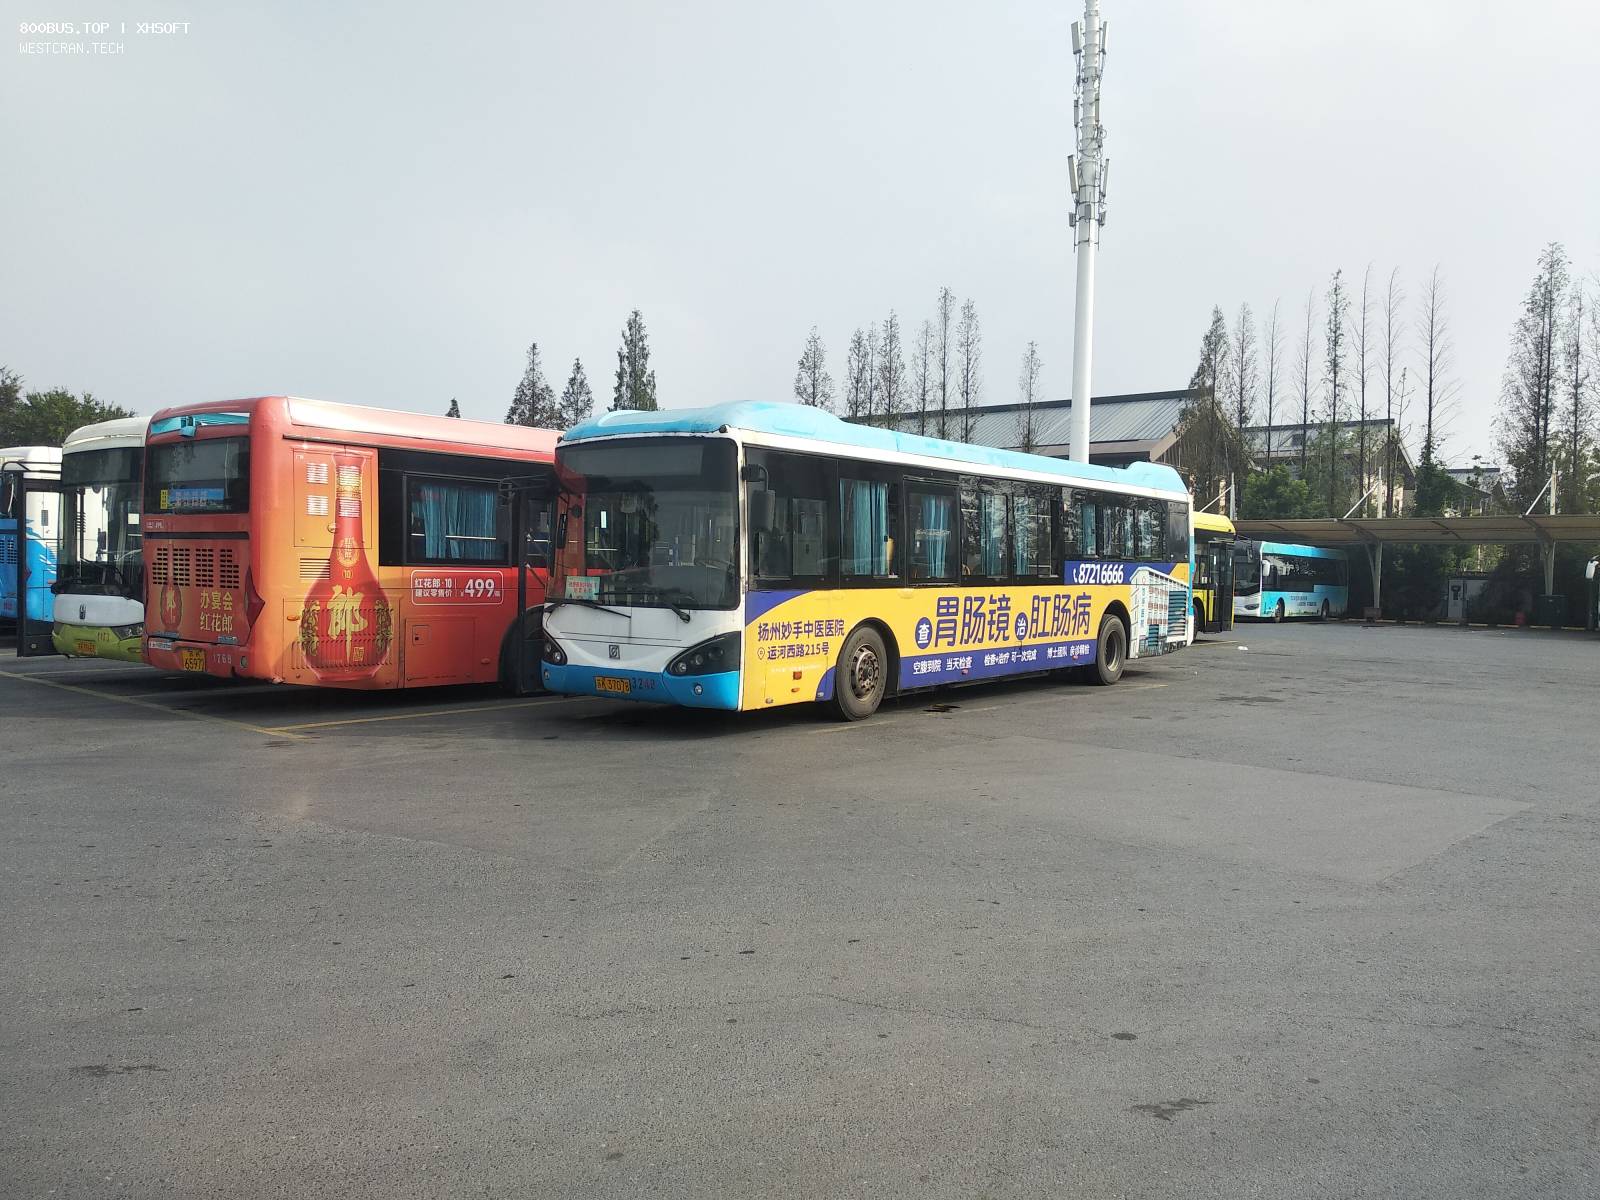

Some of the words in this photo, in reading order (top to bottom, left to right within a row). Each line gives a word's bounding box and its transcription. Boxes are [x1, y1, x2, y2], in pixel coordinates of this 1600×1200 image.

[1078, 563, 1124, 584] 87216666
[200, 590, 233, 611] 办宴会
[200, 612, 233, 634] 红花郎
[757, 619, 845, 642] 扬州妙手中医医院
[767, 641, 829, 660] 运河西路215号
[945, 656, 973, 671] 当天检查
